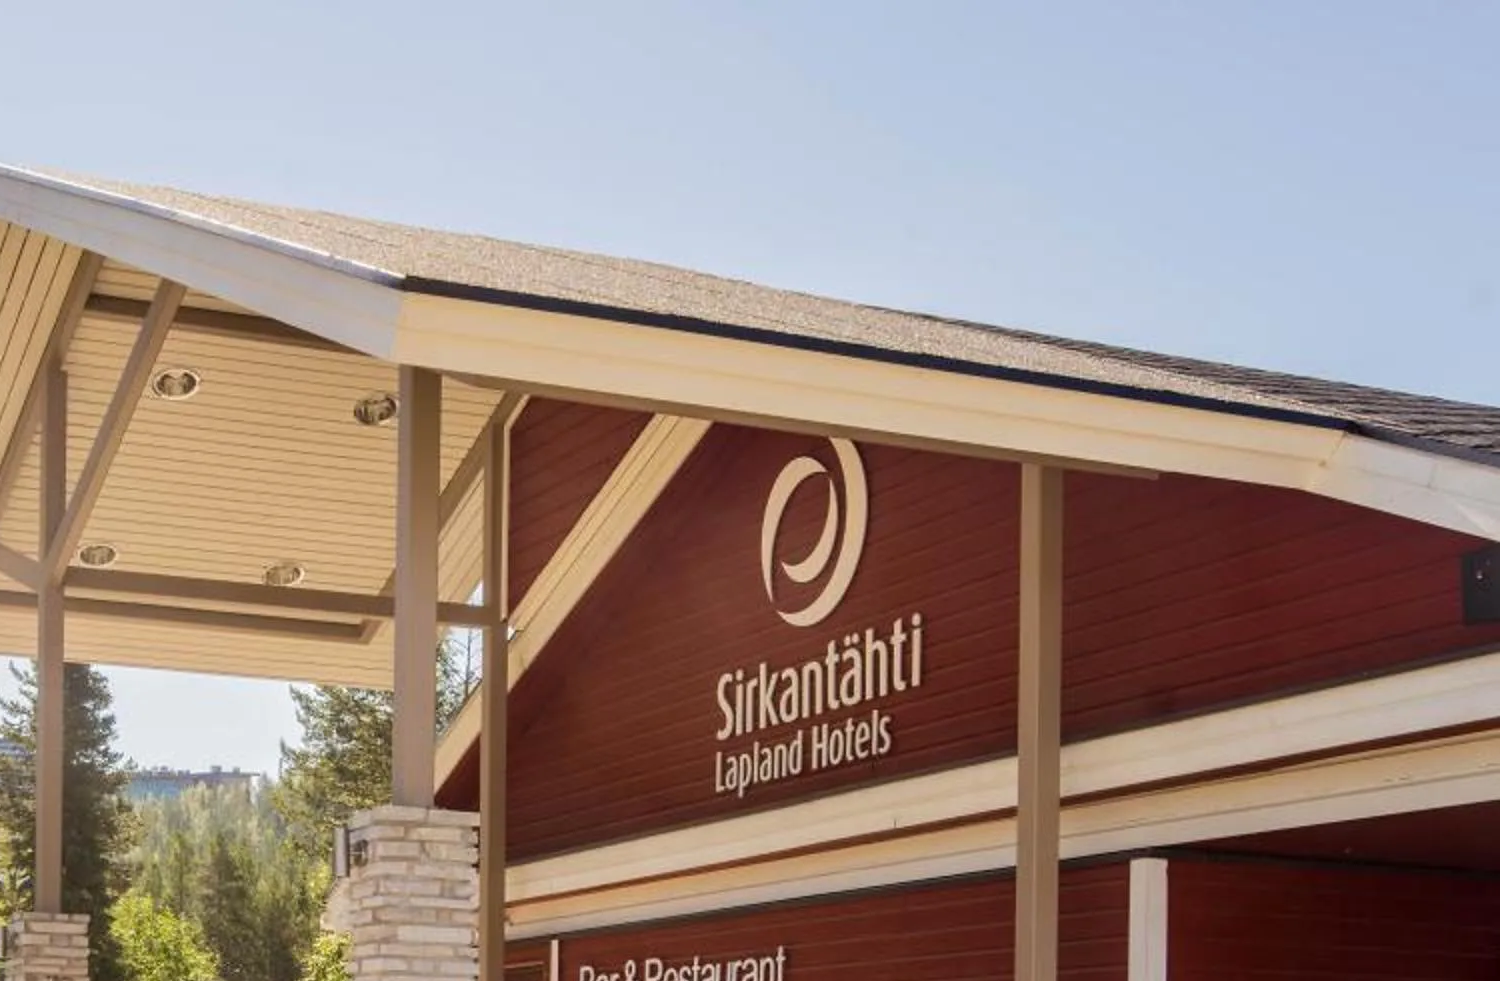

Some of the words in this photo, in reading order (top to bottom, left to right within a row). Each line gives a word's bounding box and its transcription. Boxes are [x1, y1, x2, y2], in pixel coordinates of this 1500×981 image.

[716, 613, 923, 741] Sirkantähti
[715, 730, 804, 797] Lapland
[811, 710, 892, 770] Hotels
